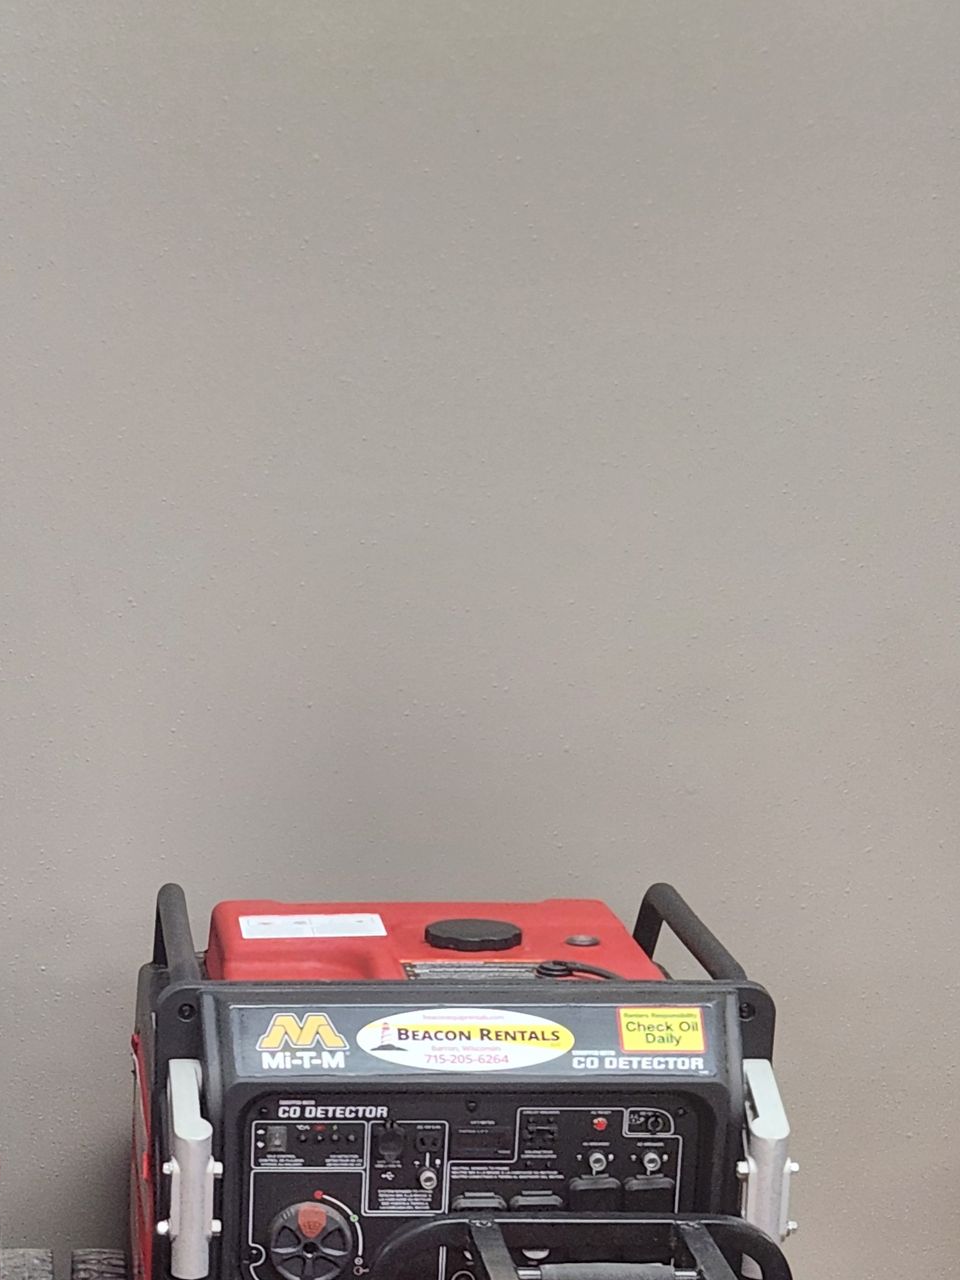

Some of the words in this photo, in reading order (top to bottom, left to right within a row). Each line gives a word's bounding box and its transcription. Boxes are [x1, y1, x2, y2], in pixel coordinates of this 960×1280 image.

[625, 1021, 674, 1032] Check
[679, 1021, 699, 1032] Oil
[397, 1028, 472, 1042] BEACON
[480, 1028, 561, 1042] RENTALS
[645, 1033, 682, 1046] Daily
[261, 1051, 346, 1069] Mi-T-M
[424, 1054, 510, 1065] 715-205-6264
[572, 1056, 599, 1070] CO
[604, 1056, 704, 1070] DETECTOR
[278, 1105, 301, 1118] CO
[304, 1105, 388, 1118] DETECTOR
